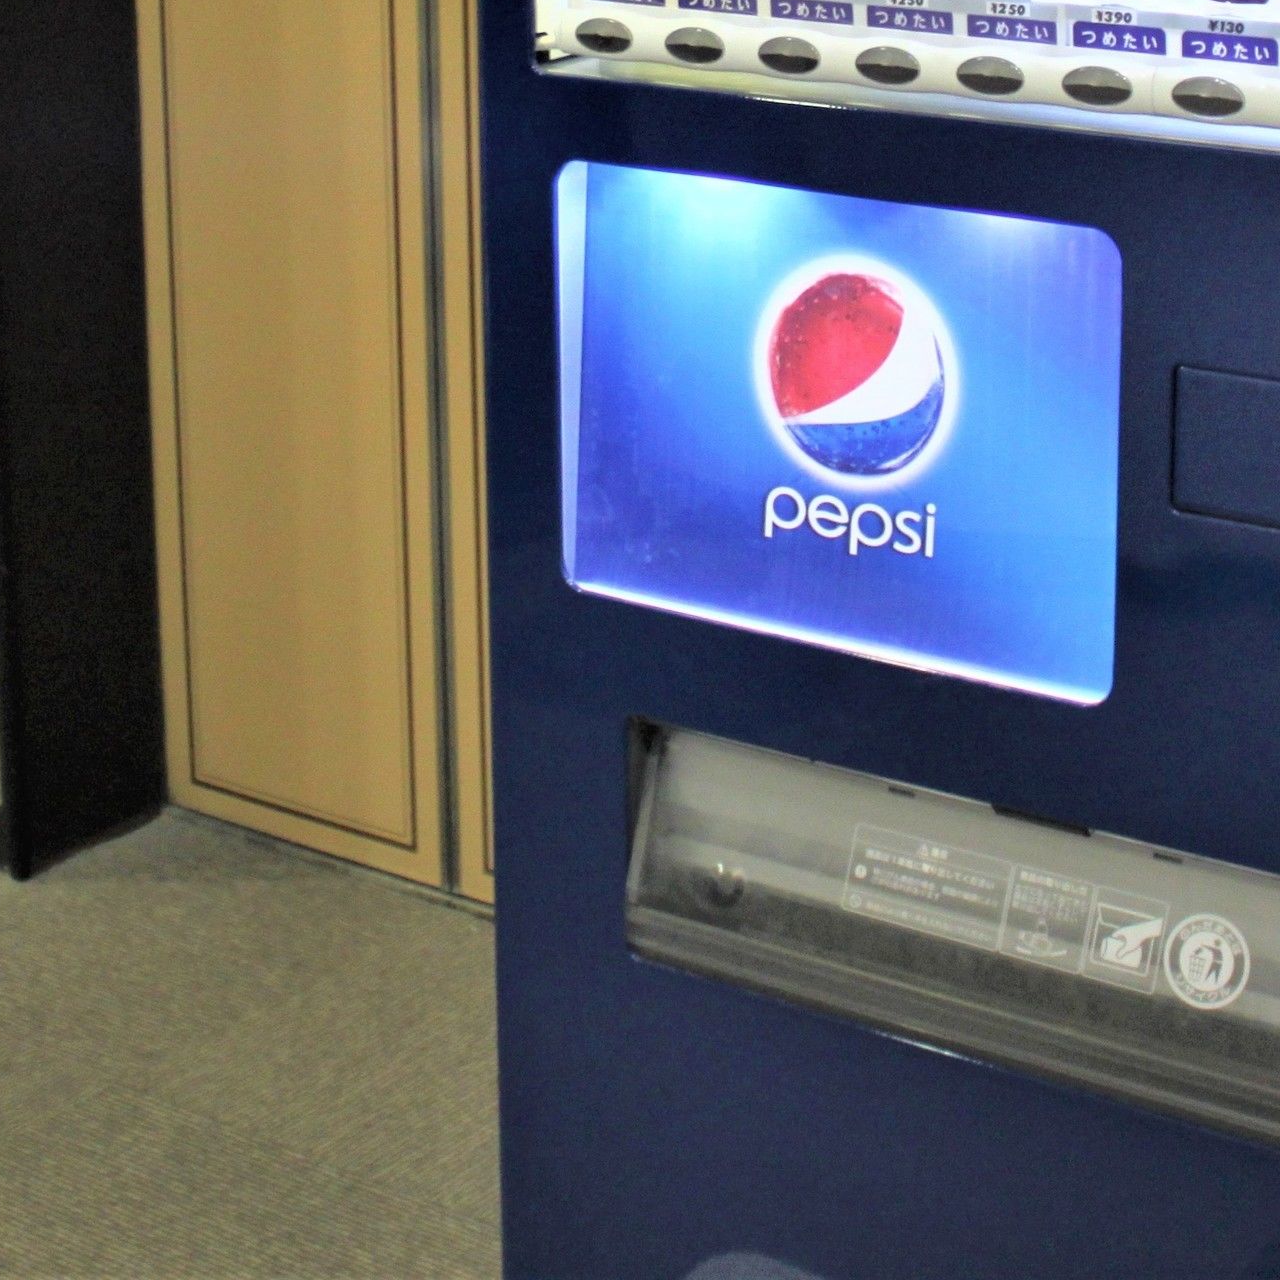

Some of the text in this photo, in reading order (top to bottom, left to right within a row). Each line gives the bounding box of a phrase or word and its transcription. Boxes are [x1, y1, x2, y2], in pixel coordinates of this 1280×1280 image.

[777, 1, 847, 21] つめたい
[991, 3, 1025, 16] ¥250
[1096, 11, 1132, 24] ¥390
[874, 11, 945, 31] つめたい
[975, 18, 1050, 40] つめたい
[1208, 20, 1244, 34] ¥130
[1082, 31, 1157, 50] つめたい
[1191, 40, 1269, 61] つめたい
[764, 486, 937, 557] pepsi
